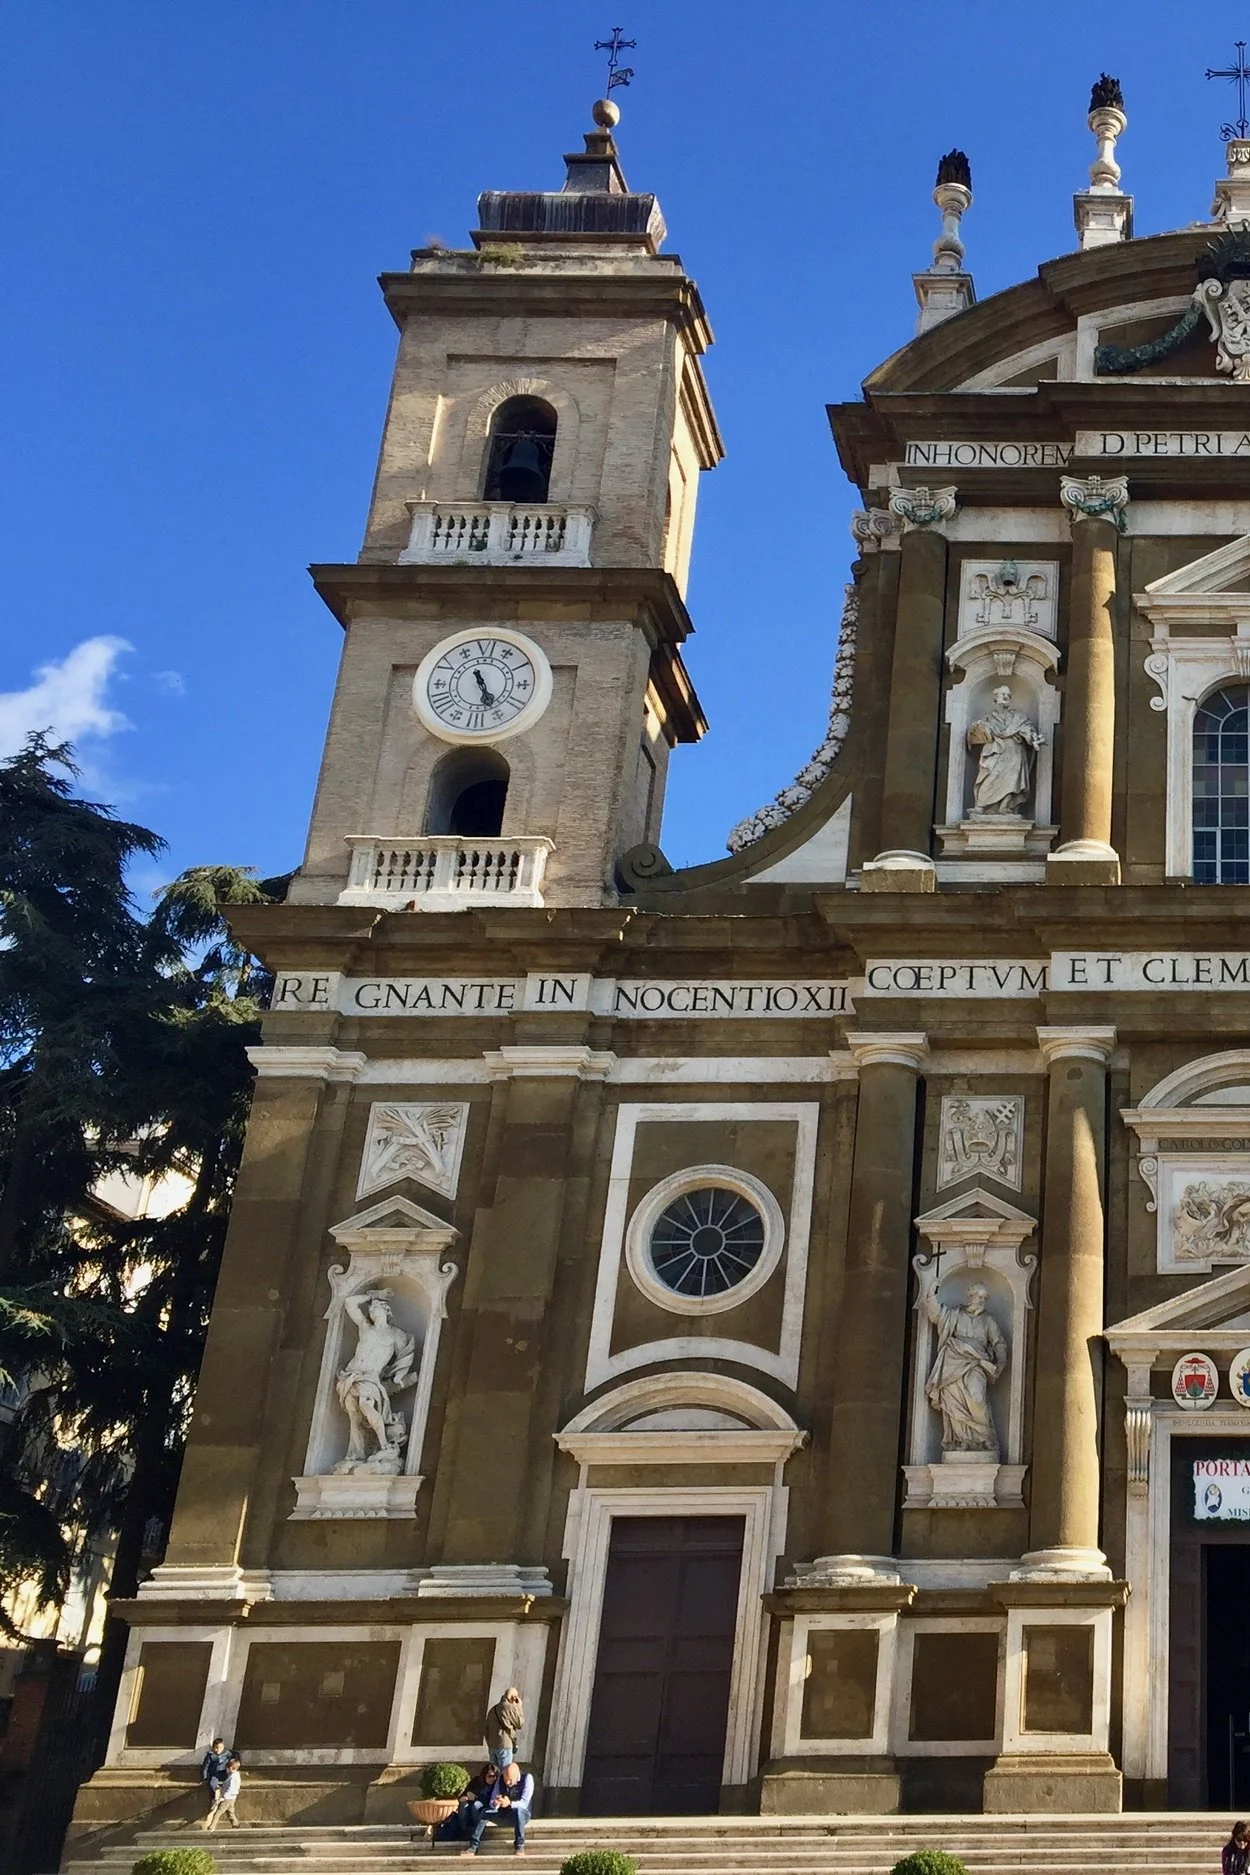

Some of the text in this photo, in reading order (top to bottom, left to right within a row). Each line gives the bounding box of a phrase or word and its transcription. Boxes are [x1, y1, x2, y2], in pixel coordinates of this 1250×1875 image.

[1100, 433, 1125, 455] D
[1133, 433, 1223, 455] PETRI
[354, 983, 517, 1010] GNANTE
[534, 978, 578, 1004] IN
[1067, 957, 1122, 984] ET
